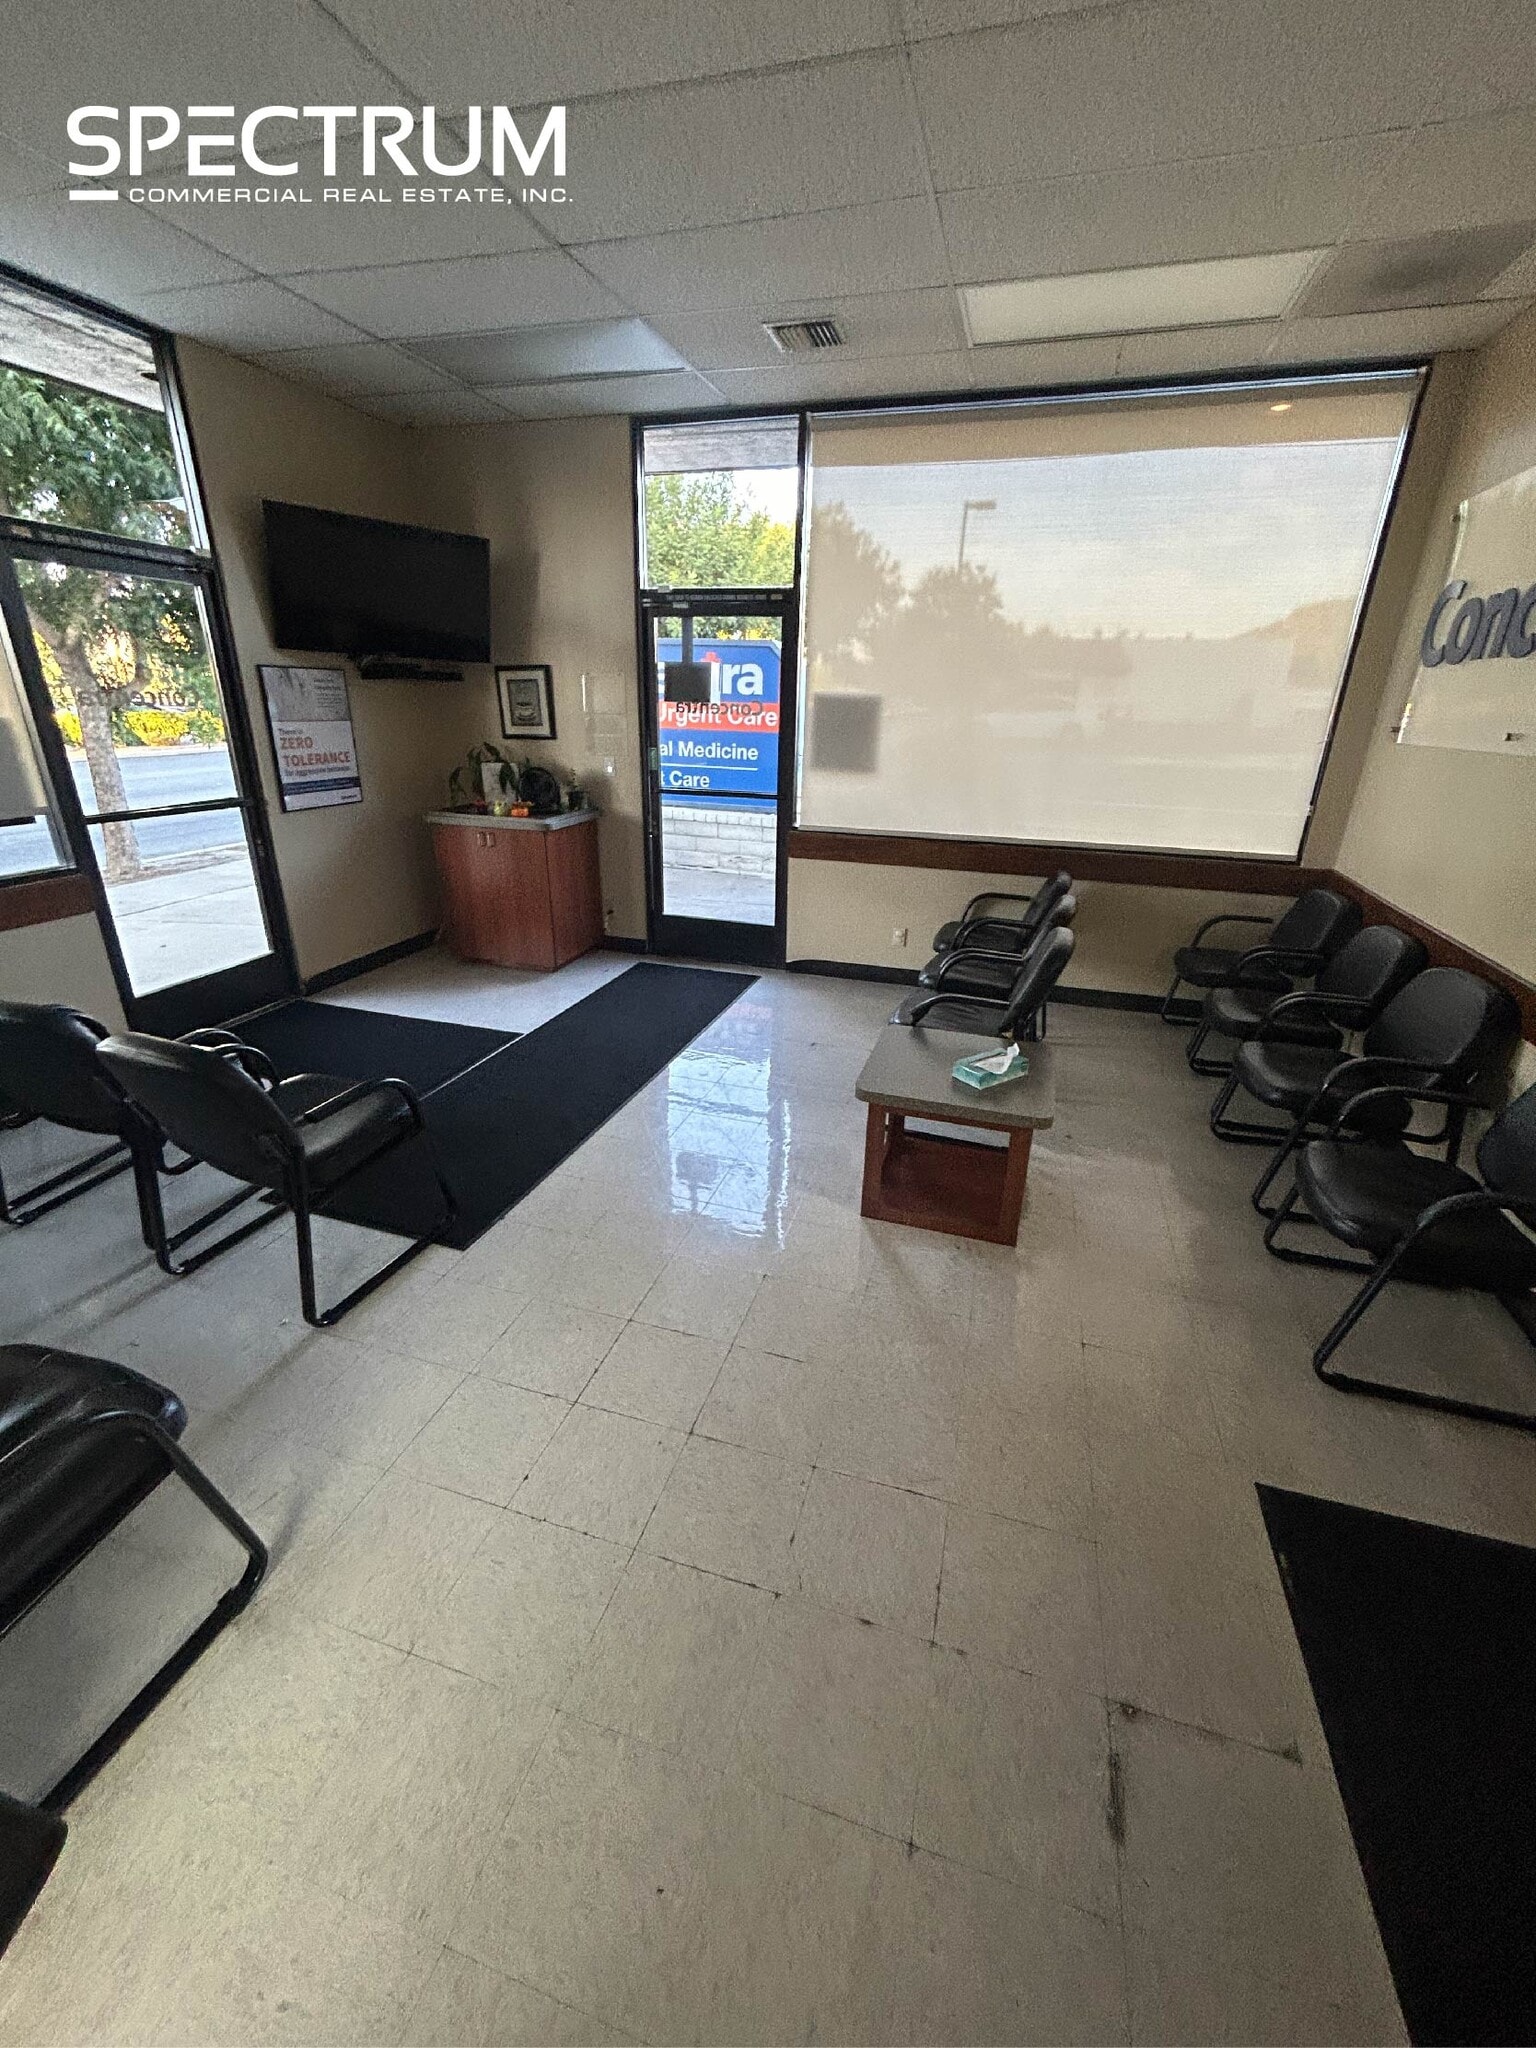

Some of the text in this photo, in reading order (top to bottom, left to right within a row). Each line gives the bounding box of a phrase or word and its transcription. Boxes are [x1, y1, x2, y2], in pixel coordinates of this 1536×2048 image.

[727, 707, 778, 727] Care
[280, 736, 313, 750] ZERO
[678, 741, 759, 761] Medicine
[282, 751, 351, 767] TOLERANCE
[669, 770, 710, 787] Care
